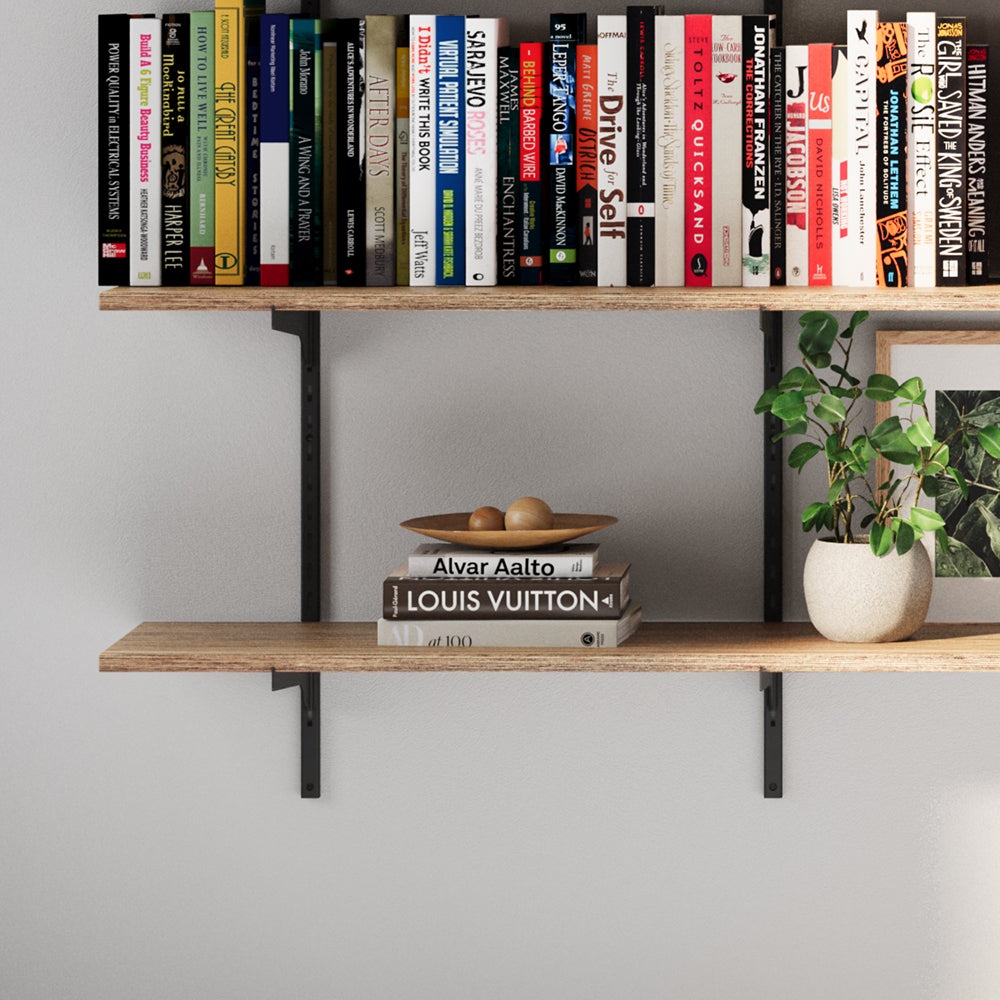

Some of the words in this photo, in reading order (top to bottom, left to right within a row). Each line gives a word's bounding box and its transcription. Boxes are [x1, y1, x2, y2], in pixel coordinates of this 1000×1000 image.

[197, 27, 207, 54] HOW
[197, 57, 207, 71] TO
[299, 49, 309, 67] John
[439, 40, 458, 78] VIRTUAL
[467, 31, 485, 107] SARAJEVO
[754, 25, 765, 114] JONATHAN
[197, 75, 207, 99] LIVE
[216, 82, 234, 103] THE
[299, 69, 309, 94] Morano
[419, 78, 429, 110] WRITE
[523, 61, 535, 106] BEHIND
[607, 72, 618, 92] The
[369, 75, 389, 128] AFTER
[439, 82, 458, 117] PATIENT
[197, 102, 207, 132] WELL
[216, 108, 235, 141] GREAT
[419, 115, 429, 138] THIS
[467, 111, 485, 155] ROSES
[523, 109, 535, 150] BARBED
[600, 95, 623, 165] Drive
[890, 90, 899, 155] JONATHAN
[369, 135, 388, 177] DAYS
[419, 141, 430, 171] BOOK
[439, 120, 458, 174] SIMULATION
[579, 128, 596, 180] OSTRICH
[754, 119, 765, 199] FRANZEN
[883, 156, 888, 166] OF
[216, 146, 234, 186] GATSBY
[523, 153, 535, 178] WIRE
[556, 168, 565, 194] DAVID
[605, 168, 617, 185] for
[692, 120, 703, 243] QUICKSAND
[890, 160, 899, 209] LETHEM
[164, 205, 183, 246] HARPER
[375, 207, 385, 232] SCOTT
[556, 196, 565, 245] MacKINNON
[600, 189, 625, 239] Self
[375, 235, 385, 276] MEDBURY
[412, 229, 428, 250] Jeff
[165, 250, 183, 268] LEE
[415, 253, 427, 278] Watts
[433, 558, 488, 576] Alvar
[493, 558, 554, 576] Aalto
[407, 590, 480, 611] LOUIS
[487, 590, 598, 611] VUITTON
